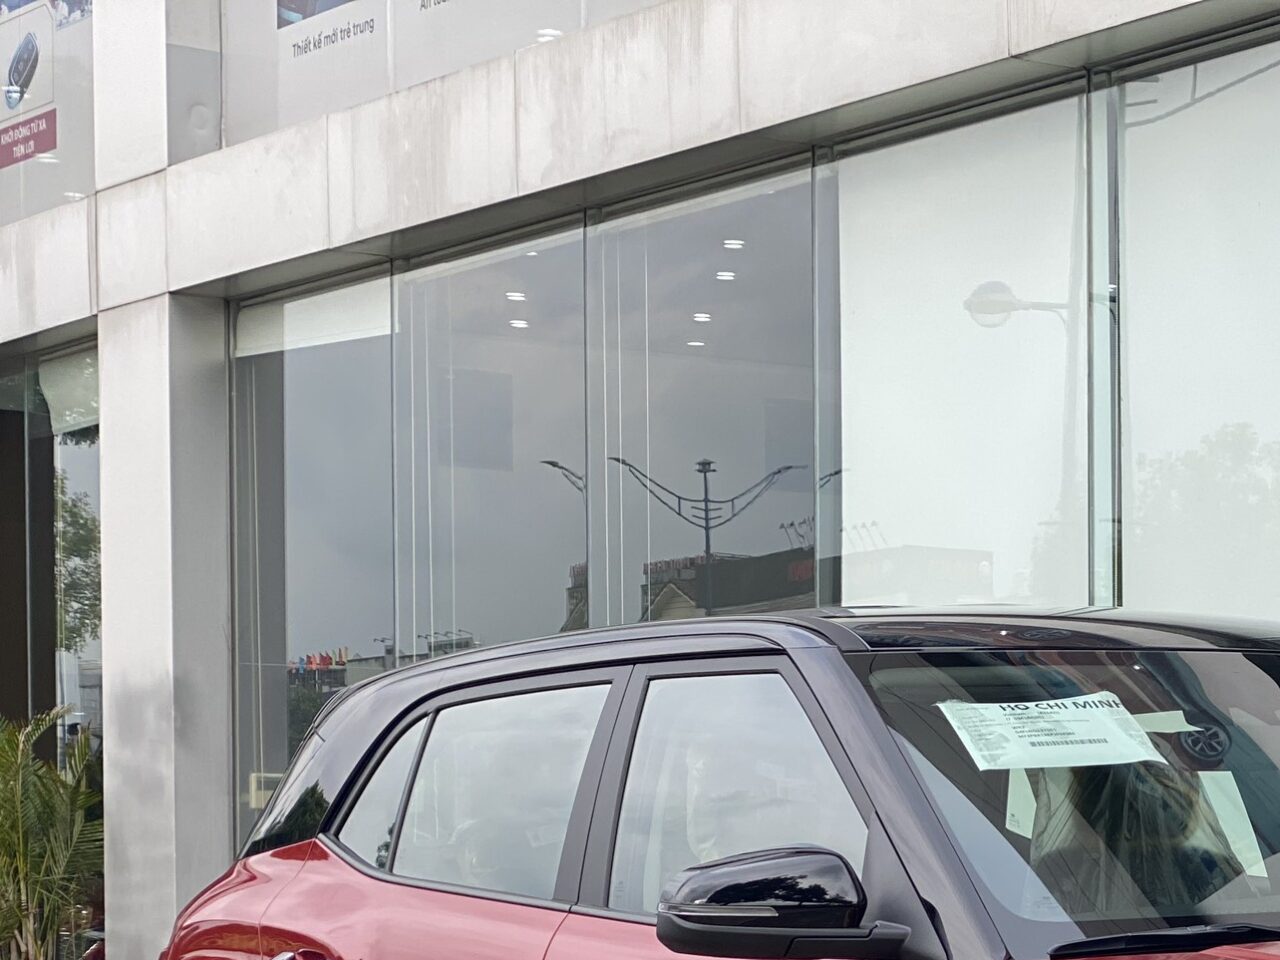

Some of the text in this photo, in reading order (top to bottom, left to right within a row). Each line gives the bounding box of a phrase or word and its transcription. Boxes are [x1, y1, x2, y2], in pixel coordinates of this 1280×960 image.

[292, 18, 374, 57] Thiết kế mới trẻ trung
[1034, 701, 1069, 711] CHI
